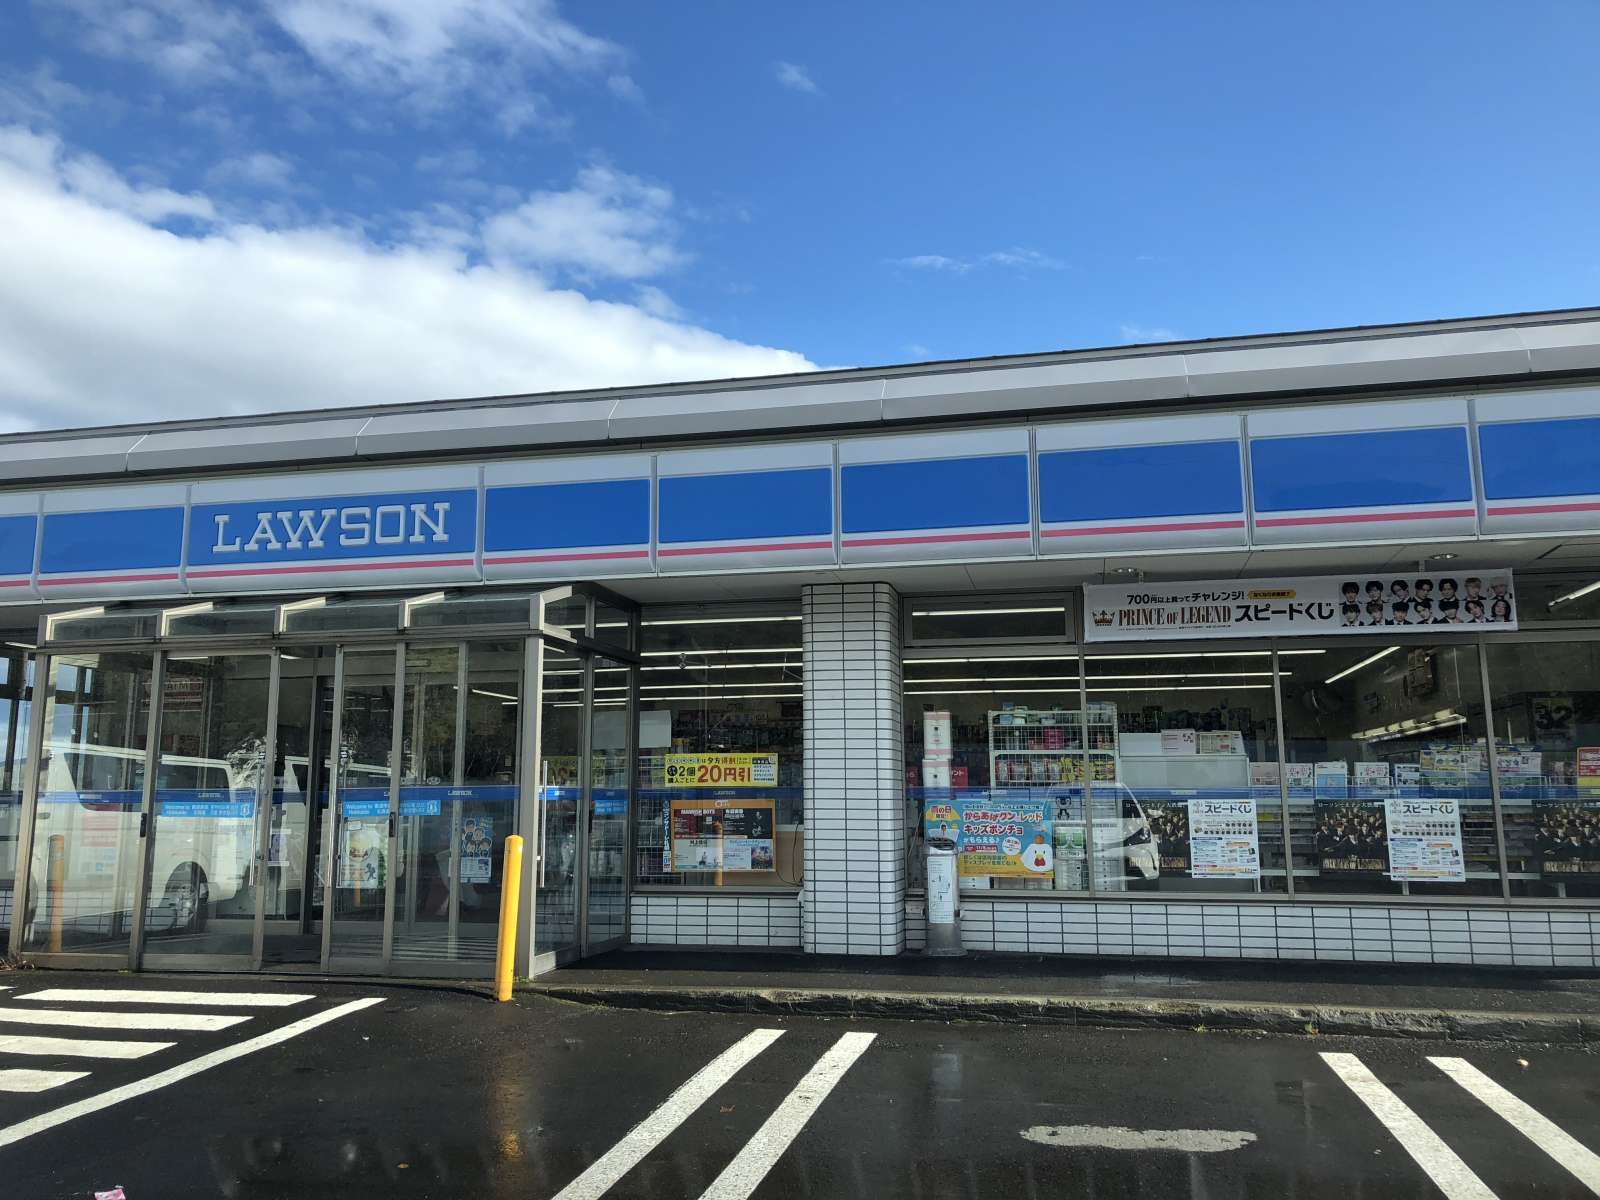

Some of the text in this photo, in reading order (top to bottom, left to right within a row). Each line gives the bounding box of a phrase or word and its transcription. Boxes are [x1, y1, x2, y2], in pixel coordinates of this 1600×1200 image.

[211, 501, 450, 555] LAWSON
[1118, 602, 1335, 627] PRINCE OF LEGEND スピードくじ
[697, 764, 751, 783] 20円引
